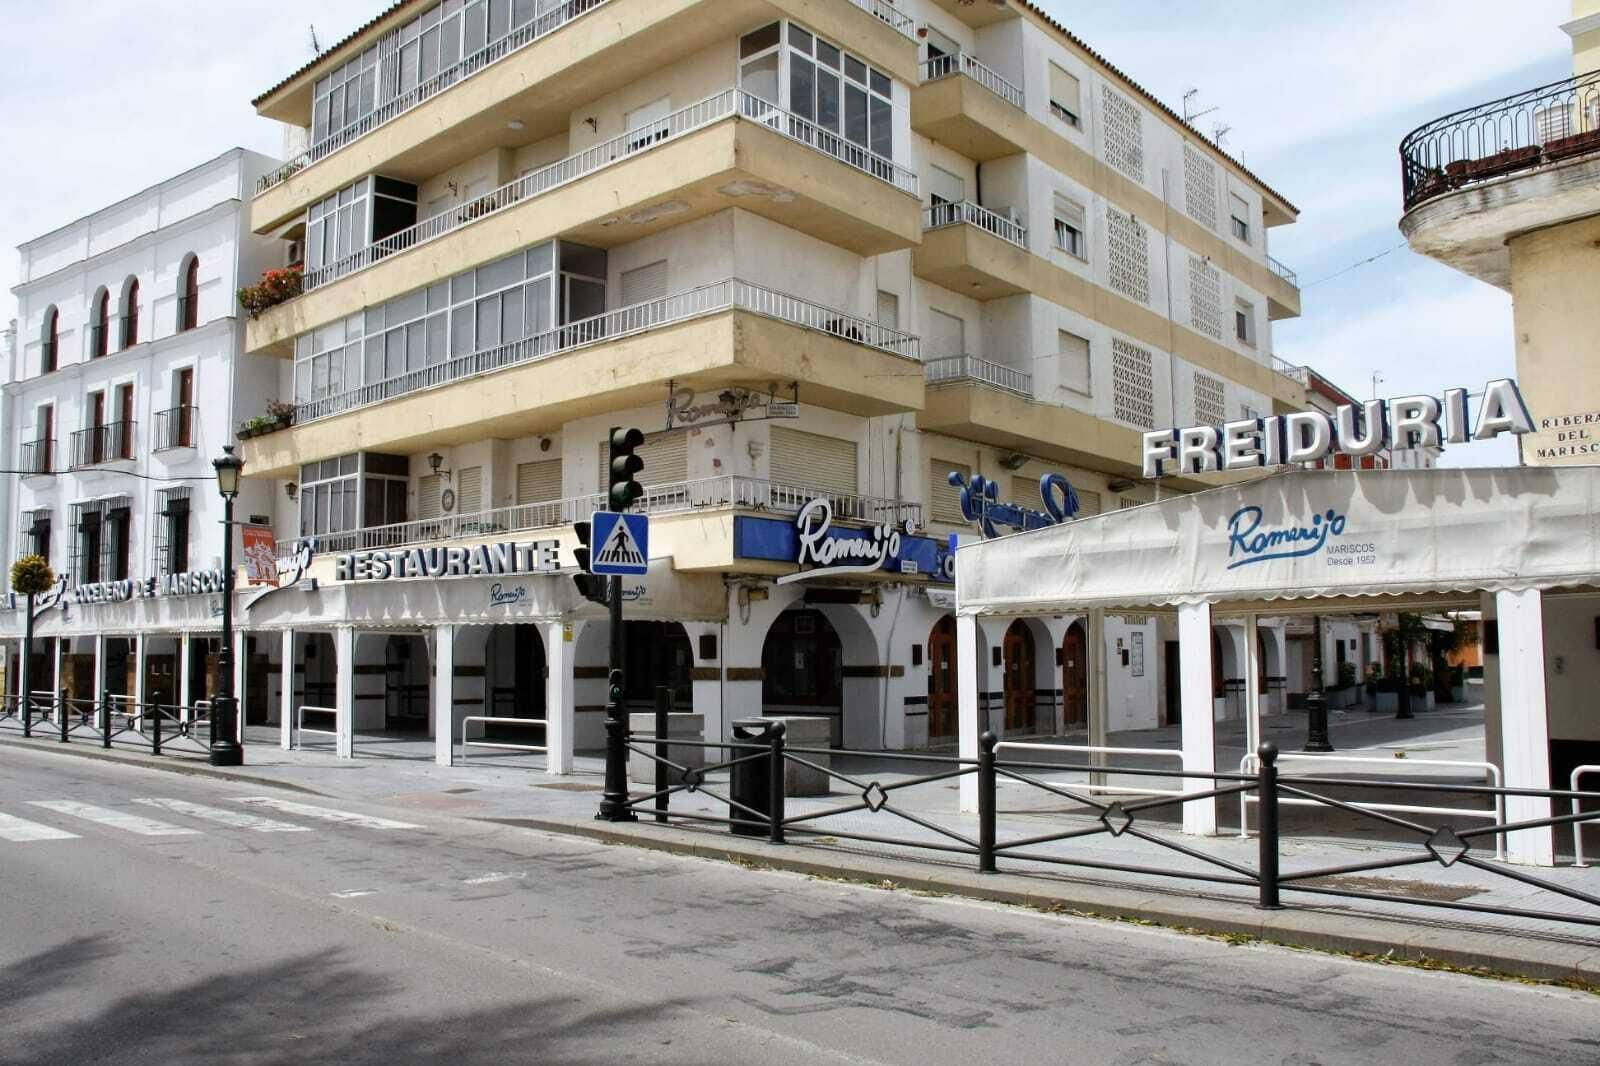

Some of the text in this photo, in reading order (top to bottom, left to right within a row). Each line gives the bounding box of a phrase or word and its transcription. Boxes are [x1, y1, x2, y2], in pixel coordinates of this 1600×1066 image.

[1143, 378, 1536, 479] FREIDURIA
[1542, 413, 1600, 428] RIBERA
[1558, 430, 1589, 441] DEL
[1227, 506, 1346, 570] Romerijo
[1327, 543, 1376, 554] MARISCOS
[336, 540, 560, 580] RESTAURANTE
[161, 567, 234, 596] MARISCO
